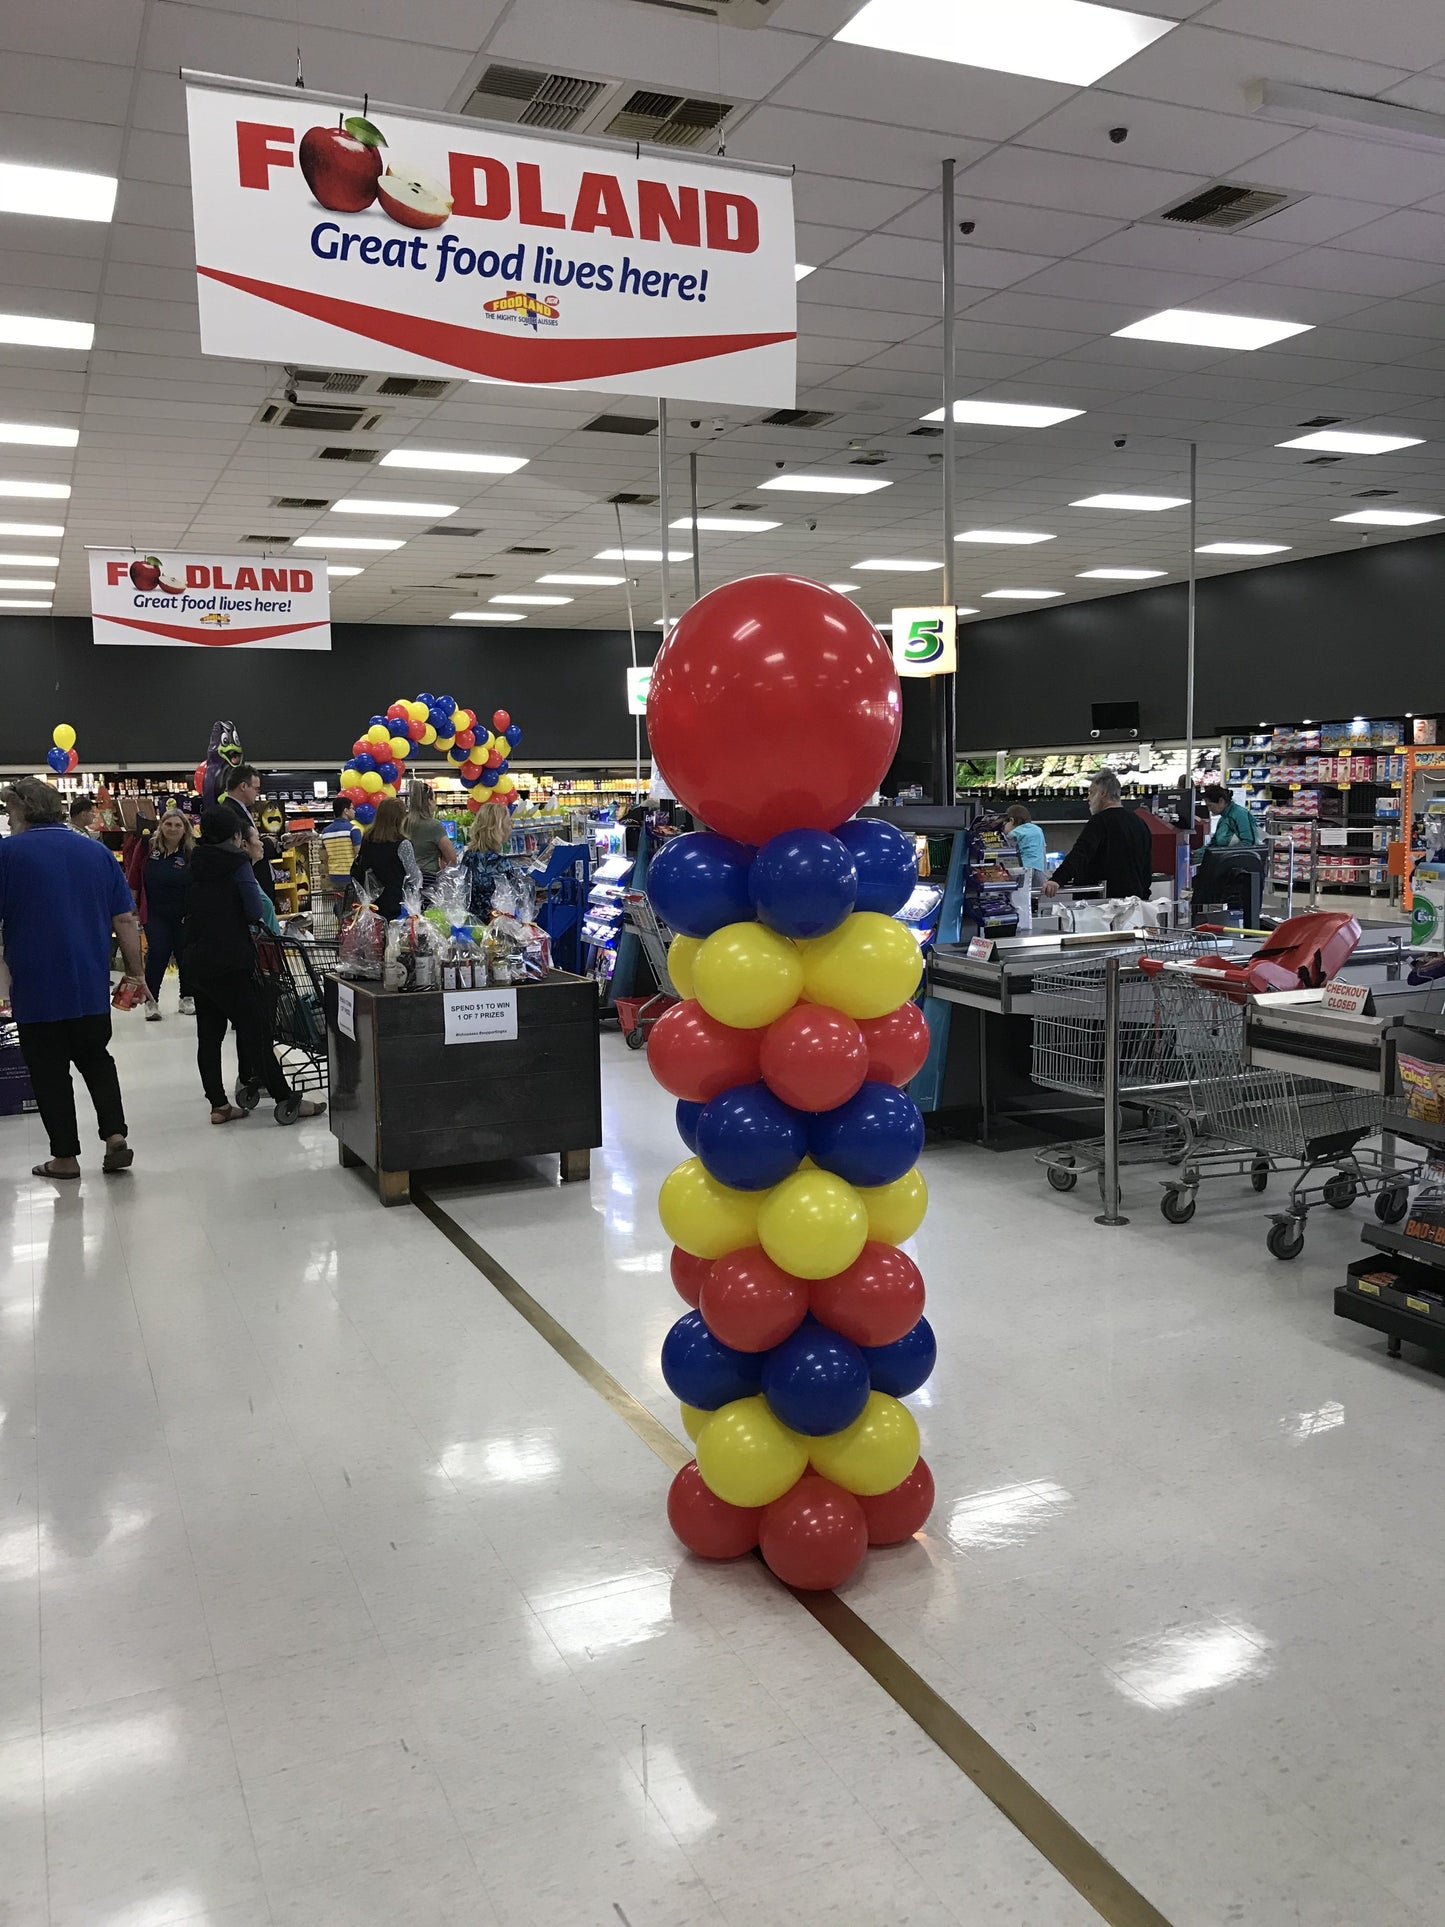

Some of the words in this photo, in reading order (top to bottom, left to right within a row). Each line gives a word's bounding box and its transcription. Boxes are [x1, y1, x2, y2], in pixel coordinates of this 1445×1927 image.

[236, 120, 760, 254] FDLAND
[310, 221, 429, 271] Great
[435, 234, 526, 283] food
[533, 245, 615, 292] lives
[619, 256, 709, 303] here!
[492, 295, 552, 317] FOODLAND
[485, 312, 495, 320] THE
[496, 313, 518, 322] MIGHTY
[538, 318, 559, 327] AUSSIES
[106, 561, 313, 594] FDLAND
[133, 594, 178, 610] Great
[180, 594, 217, 613] food
[218, 596, 252, 612] lives
[254, 597, 292, 613] here!
[903, 619, 945, 664] 5
[1326, 983, 1367, 999] CHECKOUT
[450, 1004, 475, 1012] SPEND
[476, 1003, 484, 1011] $1
[1327, 997, 1357, 1012] CLOSED
[480, 1011, 505, 1019] PRIZES
[1406, 1219, 1430, 1240] BAD
